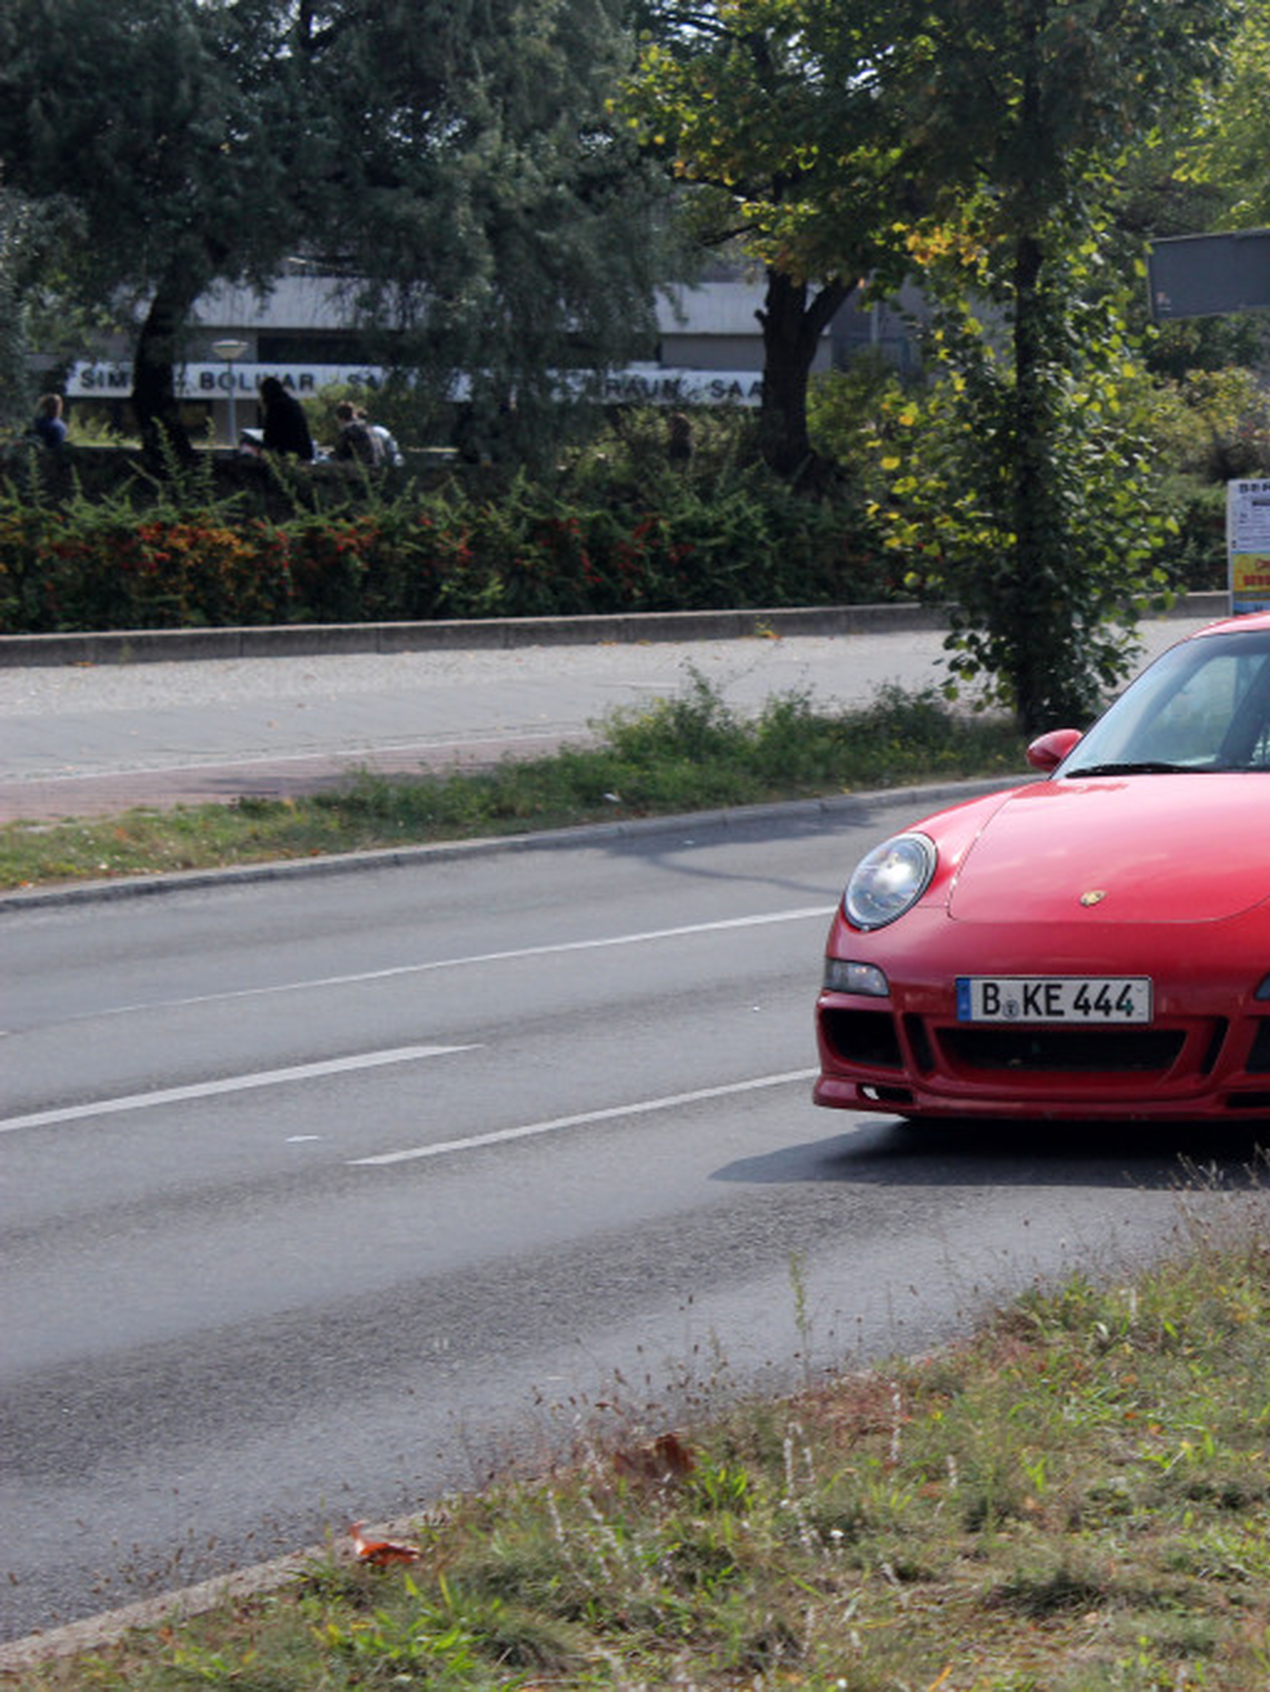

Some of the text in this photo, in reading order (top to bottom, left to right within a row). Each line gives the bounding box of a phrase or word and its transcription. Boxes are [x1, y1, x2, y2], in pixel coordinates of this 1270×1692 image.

[80, 370, 130, 389] SIM
[199, 372, 315, 391] BOLIAR
[710, 380, 764, 398] SAA
[982, 982, 1135, 1017] B KE 444
